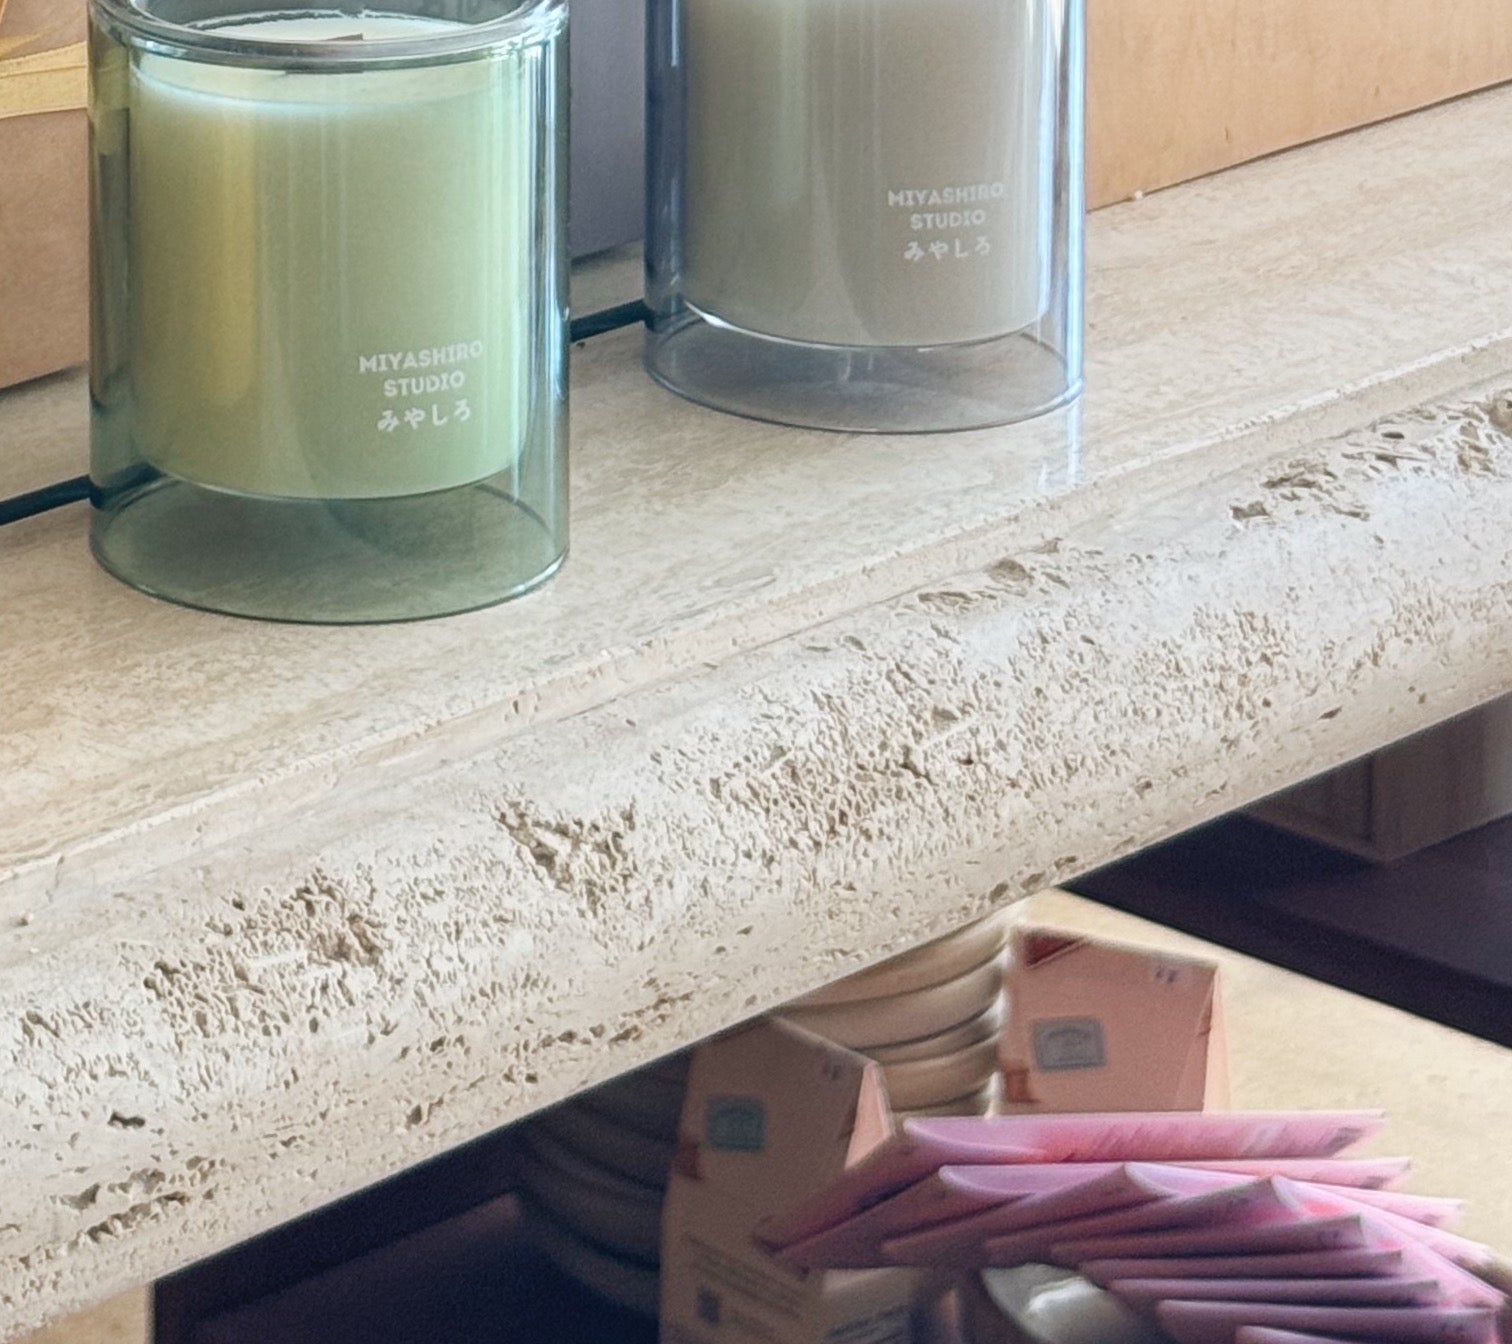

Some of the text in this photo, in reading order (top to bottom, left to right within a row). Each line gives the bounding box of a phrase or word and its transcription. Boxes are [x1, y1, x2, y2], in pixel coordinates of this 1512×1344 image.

[888, 181, 1004, 207] MIYASHIRO
[909, 209, 987, 231] STUDIO
[903, 235, 992, 261] みやしろ
[358, 340, 484, 374] MIYASHIRO
[383, 369, 466, 398] STUDIO
[377, 397, 472, 433] みやしろ
